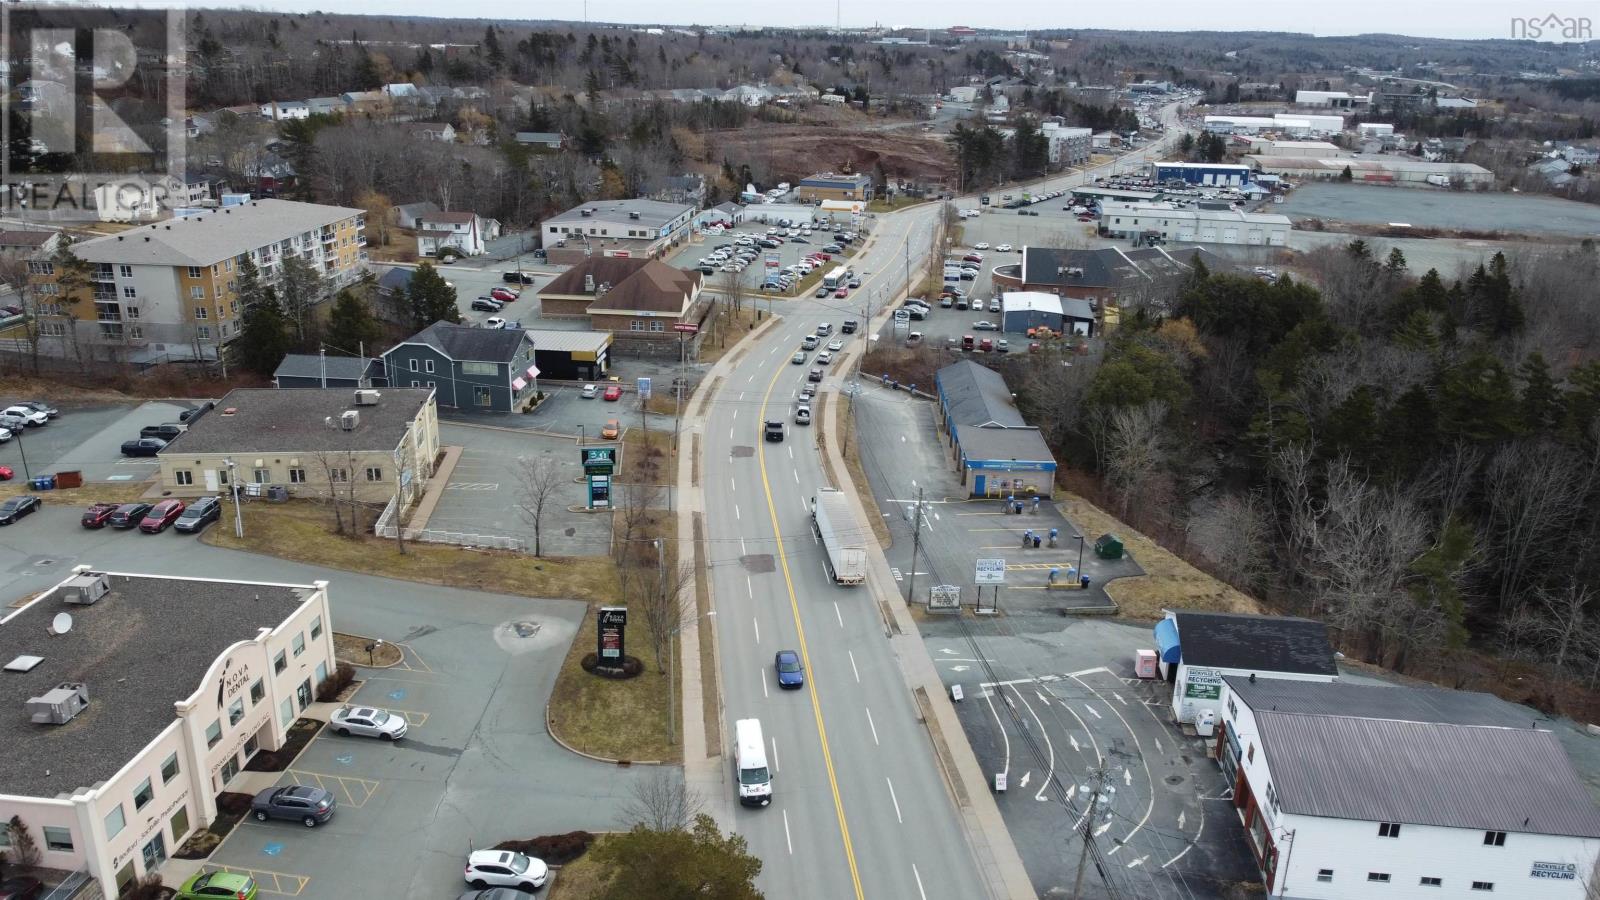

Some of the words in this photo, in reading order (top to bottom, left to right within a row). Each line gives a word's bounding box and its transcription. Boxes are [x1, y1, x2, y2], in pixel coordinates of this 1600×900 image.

[1188, 676, 1222, 684] RECYCLING
[228, 674, 250, 698] DENTAL
[1531, 870, 1574, 879] RECYCLING
